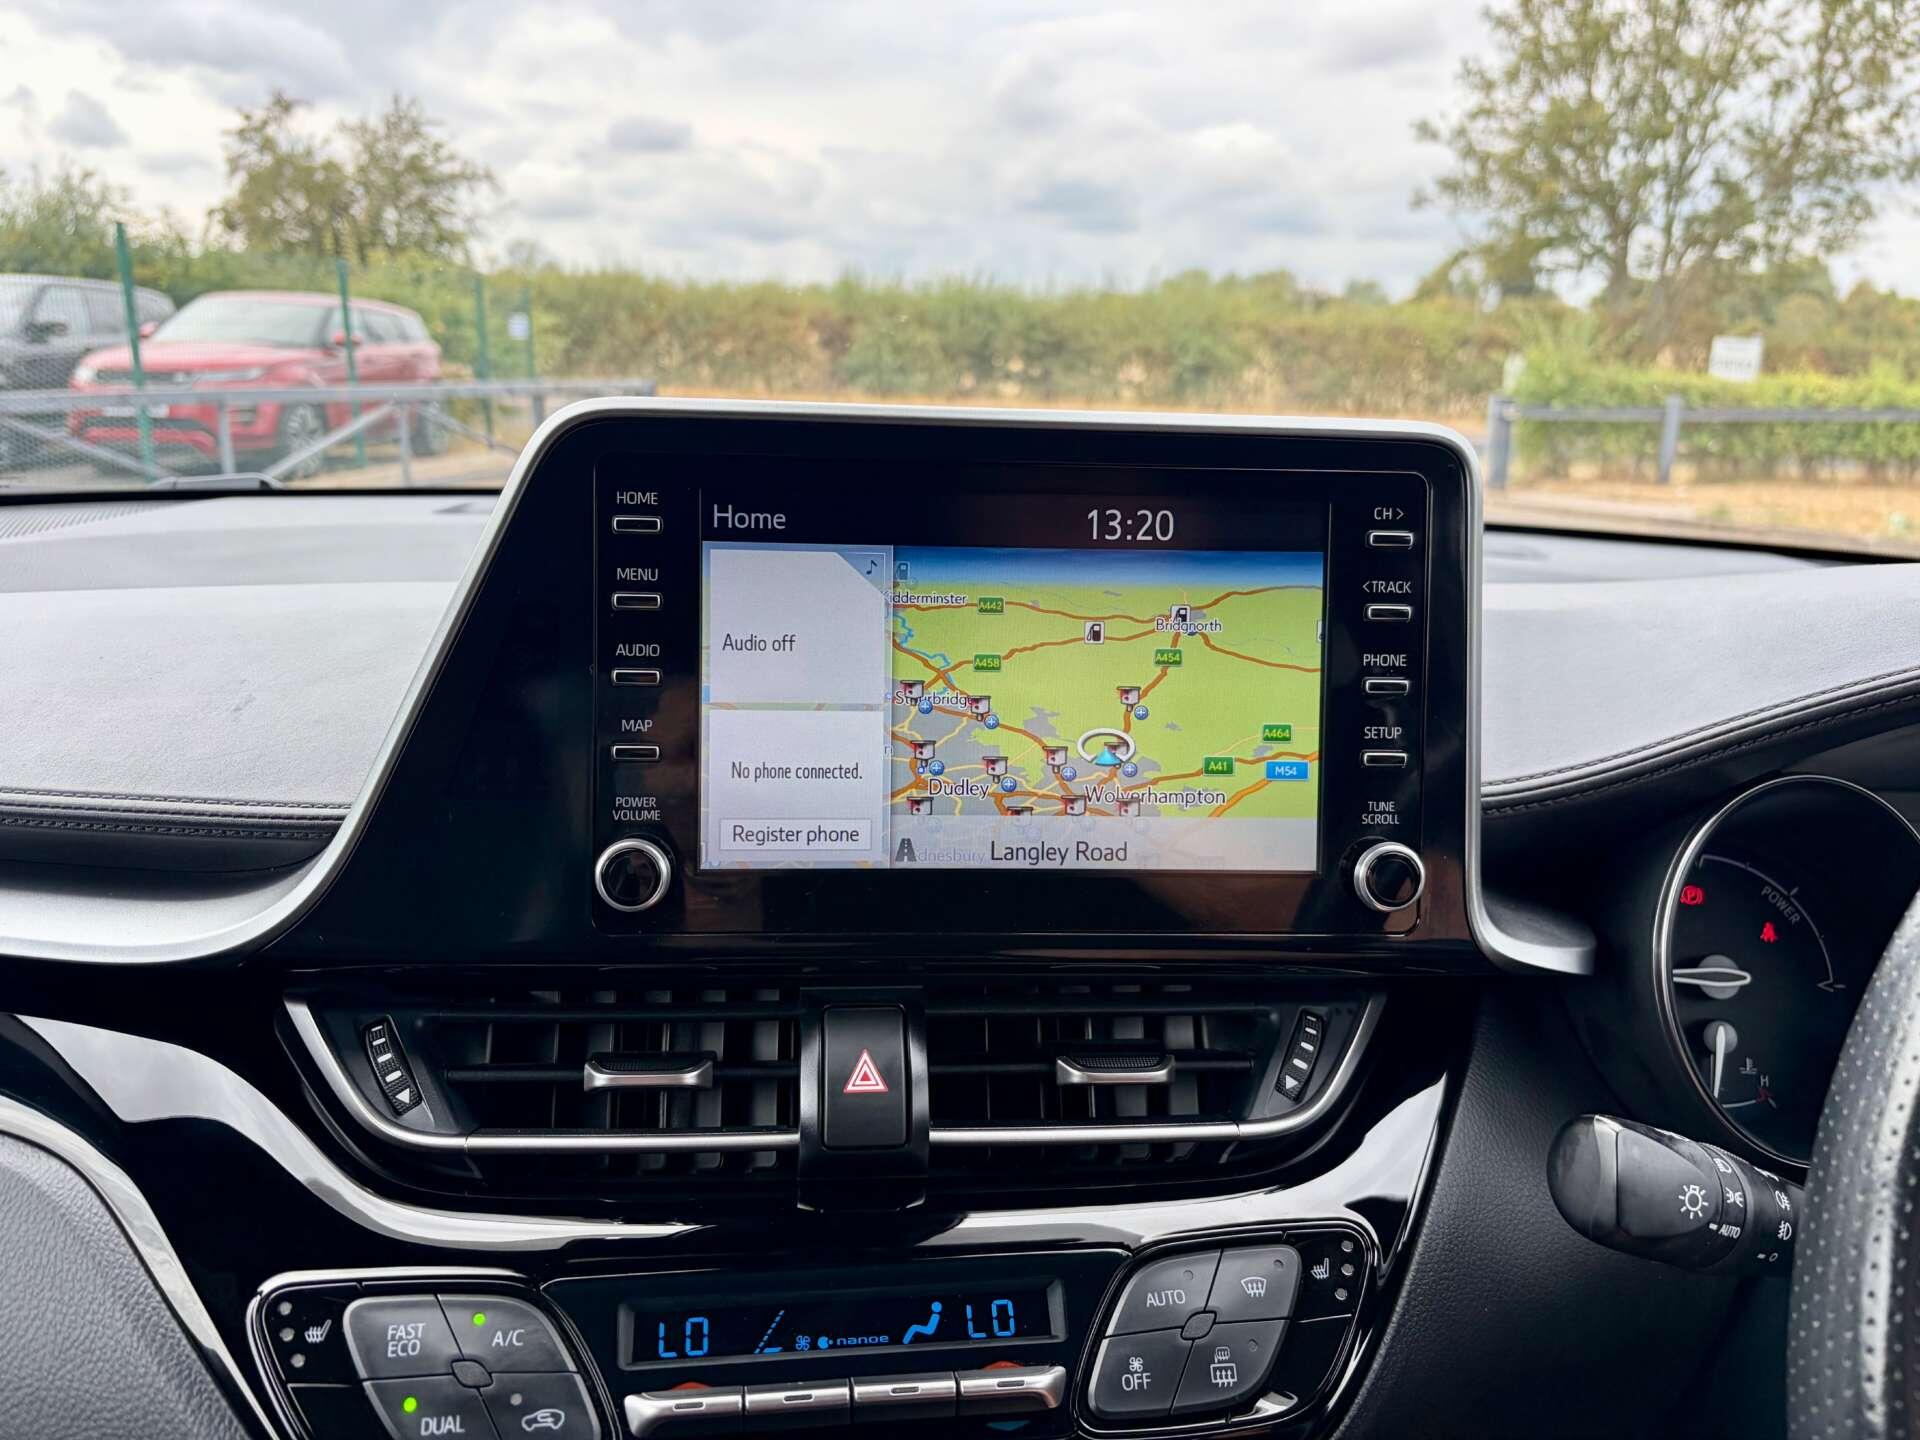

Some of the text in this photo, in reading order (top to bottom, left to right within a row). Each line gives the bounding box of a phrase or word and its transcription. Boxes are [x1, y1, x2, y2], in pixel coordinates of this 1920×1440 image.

[616, 491, 659, 505] HOME
[712, 504, 787, 529] Home
[1087, 509, 1175, 541] 13:20
[616, 567, 659, 581] MENU
[979, 600, 1003, 612] A442
[1155, 618, 1222, 633] Bridgnorth
[615, 643, 661, 657] AUDIO
[722, 634, 797, 653] Audio off
[975, 657, 1001, 668] A458
[1155, 652, 1181, 663] A454
[1362, 653, 1407, 667] PHONE
[621, 719, 653, 732] MAP
[1363, 726, 1402, 739] SETUP
[1264, 728, 1291, 739] A464
[731, 761, 863, 782] No phone connected.
[1209, 760, 1228, 772] A41
[1274, 765, 1297, 776] M54
[928, 778, 989, 798] Dudley
[615, 796, 657, 808] POWER
[1085, 785, 1226, 806] Wolverhampton
[1367, 801, 1395, 812] TUNE
[612, 809, 661, 821] VOLUME
[1361, 813, 1400, 825] SCROLL
[732, 824, 860, 846] Register phone
[991, 840, 1128, 866] Langley Road
[1761, 885, 1800, 925] POWER
[1717, 1223, 1741, 1239] AUTO
[1146, 1289, 1186, 1308] AUTO
[387, 1323, 426, 1340] FAST
[491, 1329, 525, 1348] A/C
[836, 1334, 889, 1346] nanoe
[387, 1340, 420, 1358] ECO
[1121, 1373, 1152, 1392] OFF
[420, 1415, 466, 1437] DUAL
